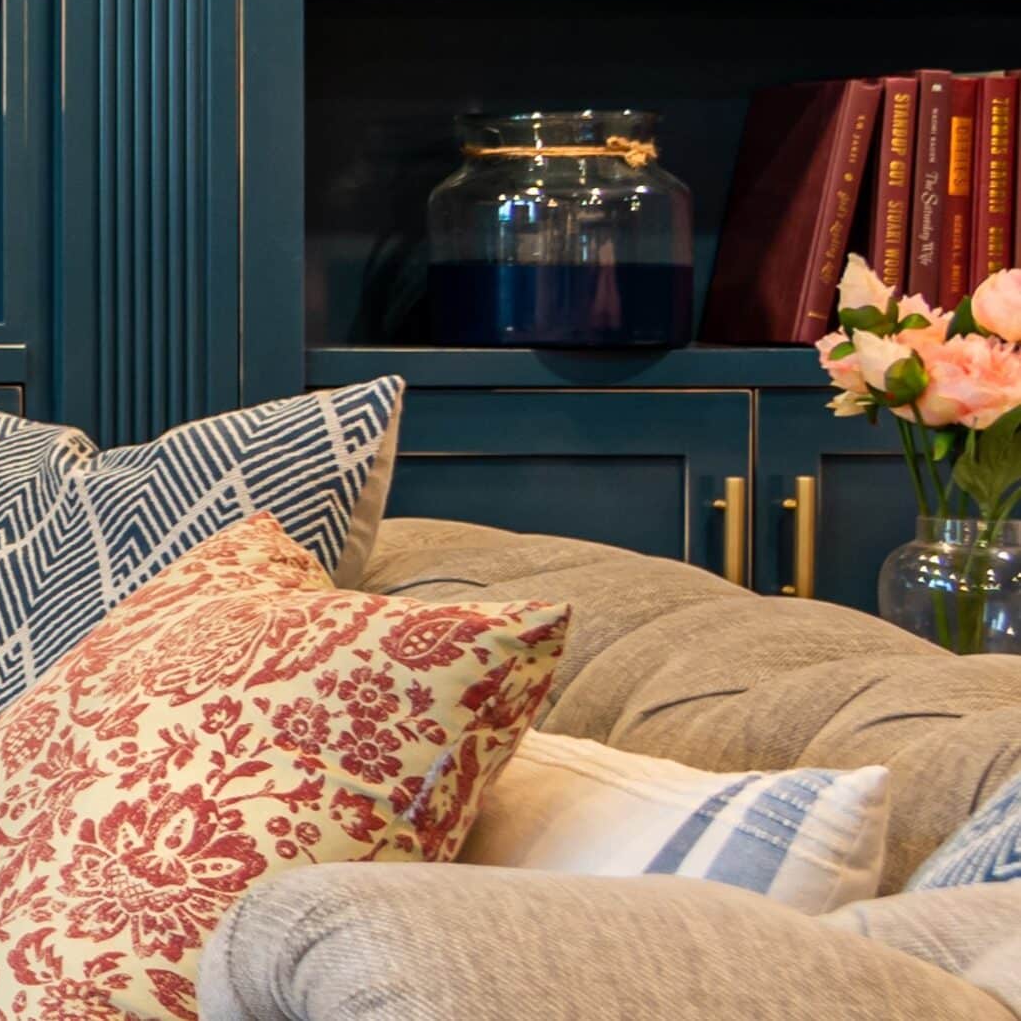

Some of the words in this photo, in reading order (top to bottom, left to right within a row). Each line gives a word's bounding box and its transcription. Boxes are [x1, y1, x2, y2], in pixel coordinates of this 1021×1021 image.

[892, 92, 911, 156] STANDUP
[991, 97, 1010, 156] THOMAS
[888, 161, 905, 187] GUY
[924, 172, 939, 191] The
[989, 160, 1008, 214] HARRIS
[886, 201, 904, 244] STUART
[919, 191, 938, 245] Saturday
[883, 248, 901, 287] WOOD
[917, 243, 935, 266] Wife
